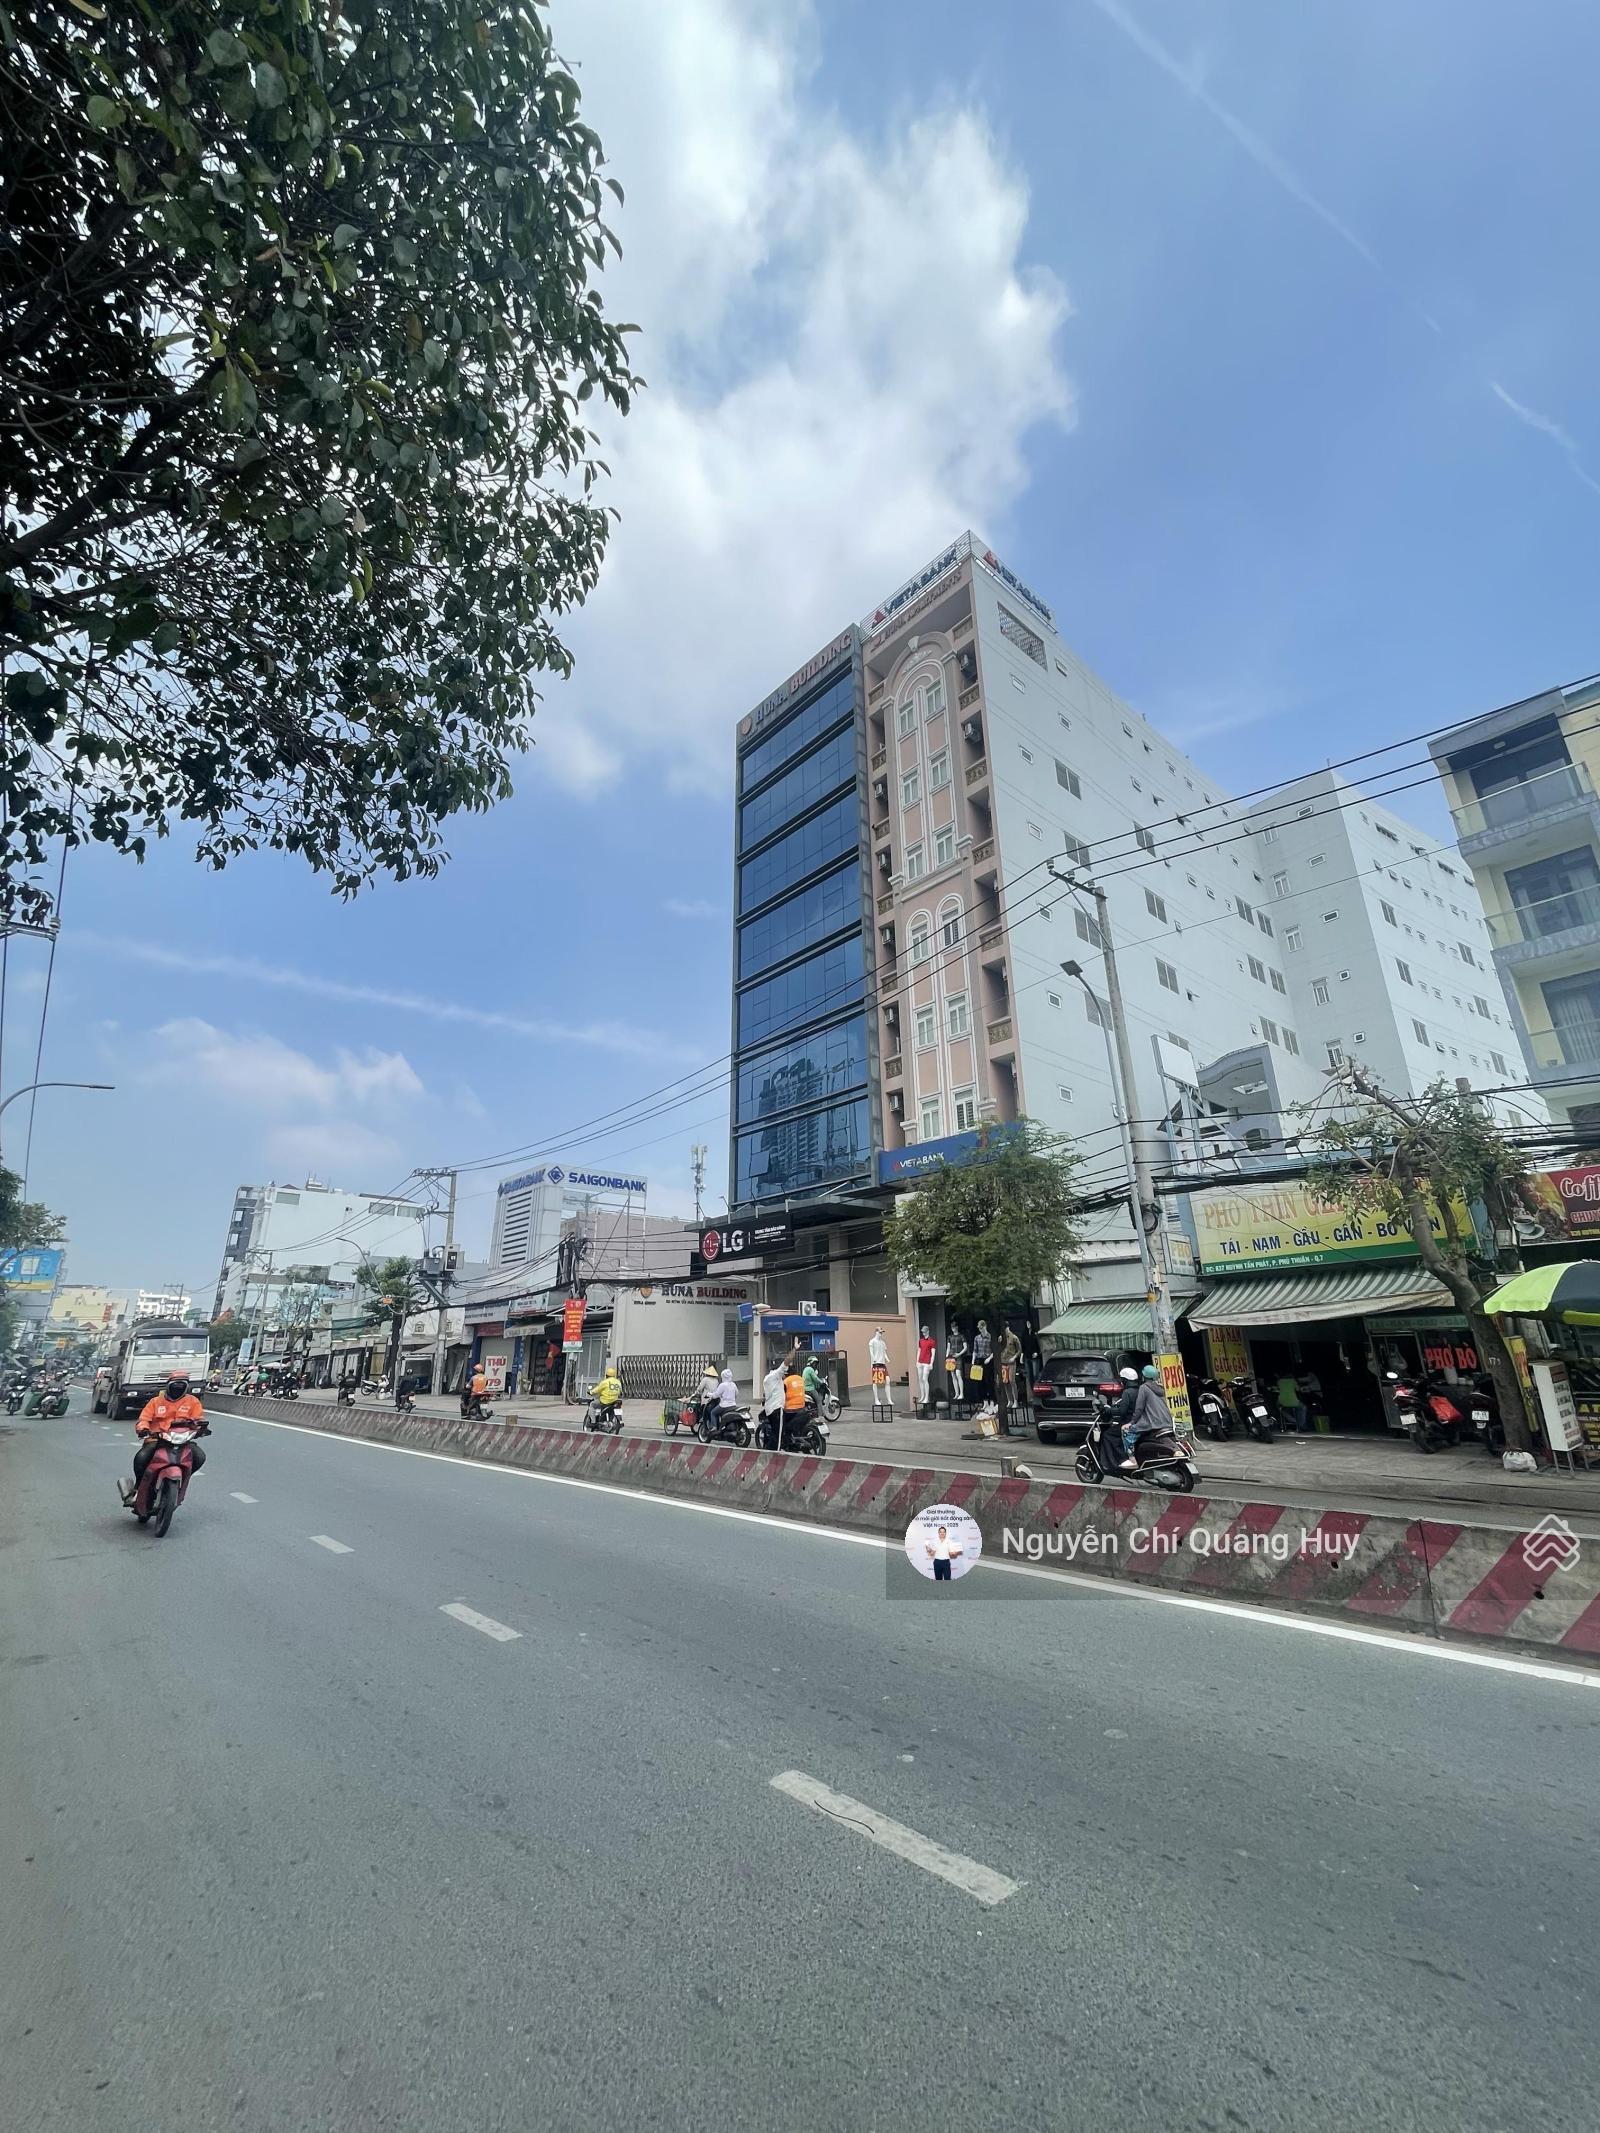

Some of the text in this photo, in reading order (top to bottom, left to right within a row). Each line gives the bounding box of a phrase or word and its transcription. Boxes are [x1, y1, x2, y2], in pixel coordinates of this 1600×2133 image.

[790, 634, 853, 694] BUILDING
[569, 1172, 646, 1192] SAIGONBANK
[722, 1229, 744, 1253] LG
[1220, 1237, 1241, 1255] TÁI
[1252, 1235, 1281, 1254] NẠM
[1293, 1226, 1320, 1247] GẦU
[696, 1286, 748, 1299] BUILDING
[1456, 1342, 1477, 1369] BÒ
[492, 1368, 500, 1376] Y
[872, 1371, 885, 1384] 49
